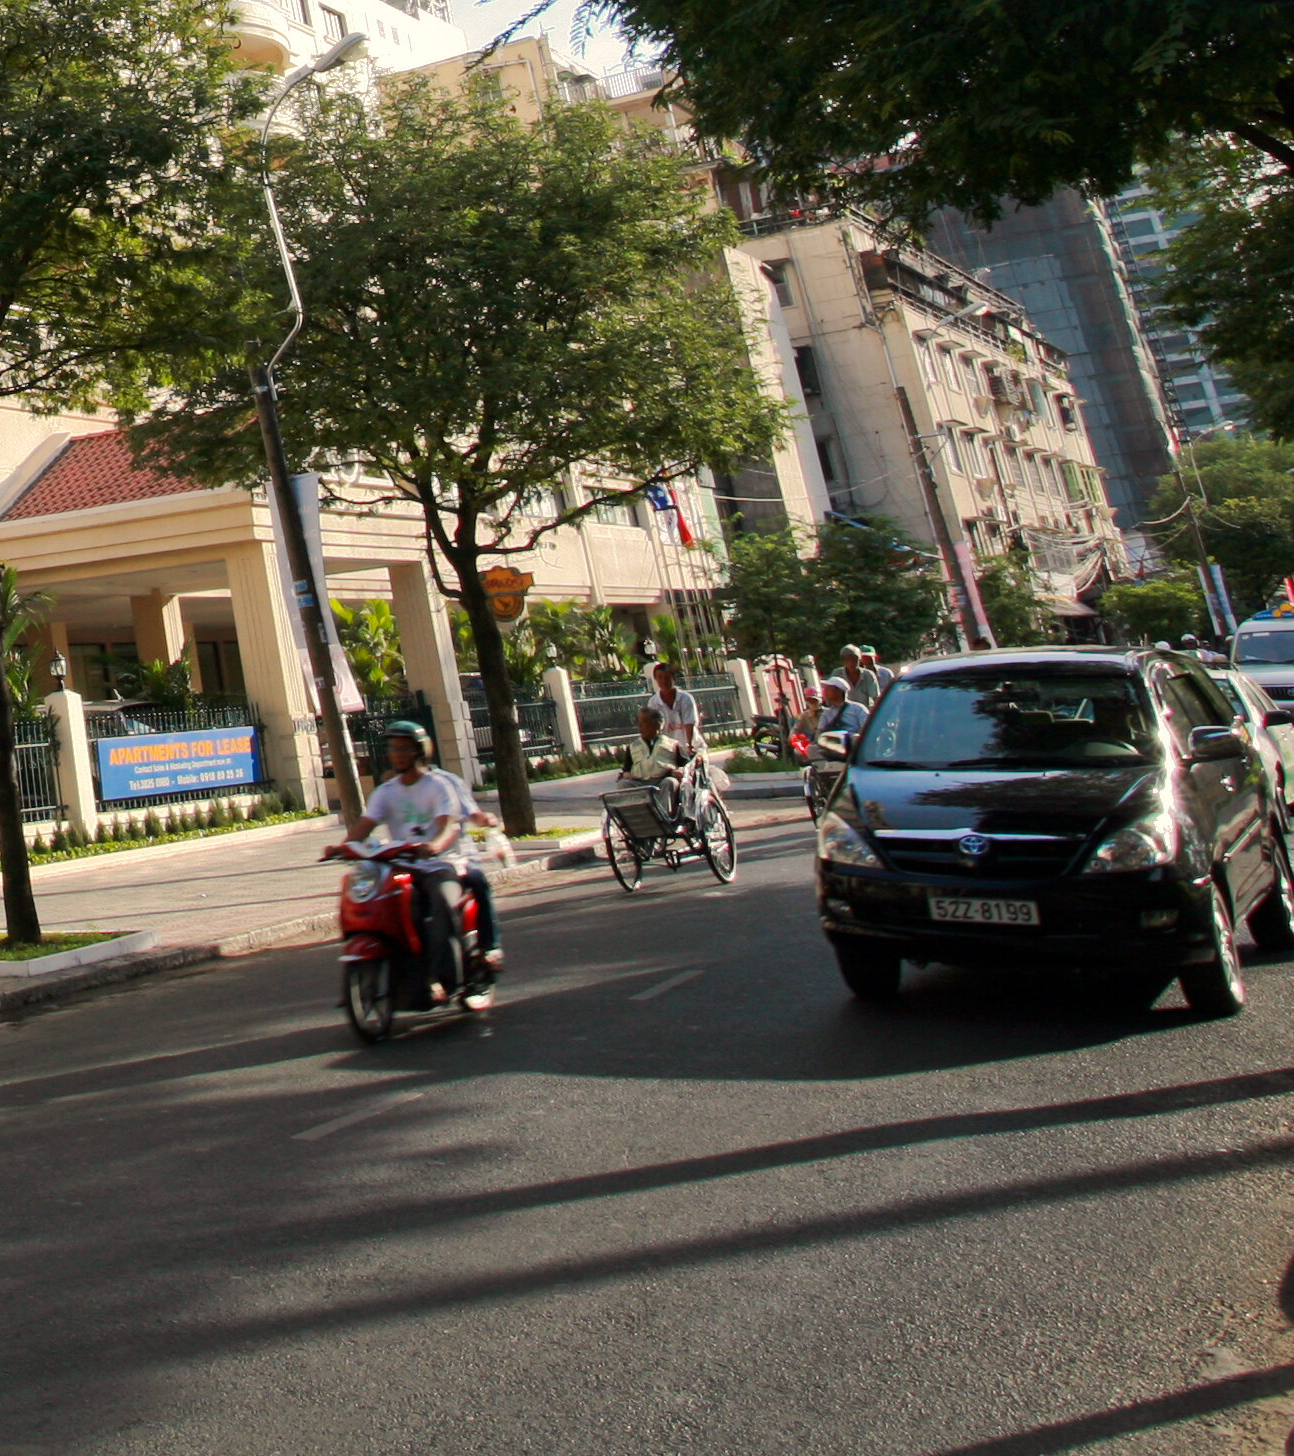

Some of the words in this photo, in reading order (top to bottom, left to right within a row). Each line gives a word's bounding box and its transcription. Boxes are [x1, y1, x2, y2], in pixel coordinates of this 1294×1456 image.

[109, 742, 189, 765] APARTMENTS
[191, 739, 213, 757] FOR
[217, 736, 251, 755] LEASE
[934, 899, 1033, 922] 52Z-8199
